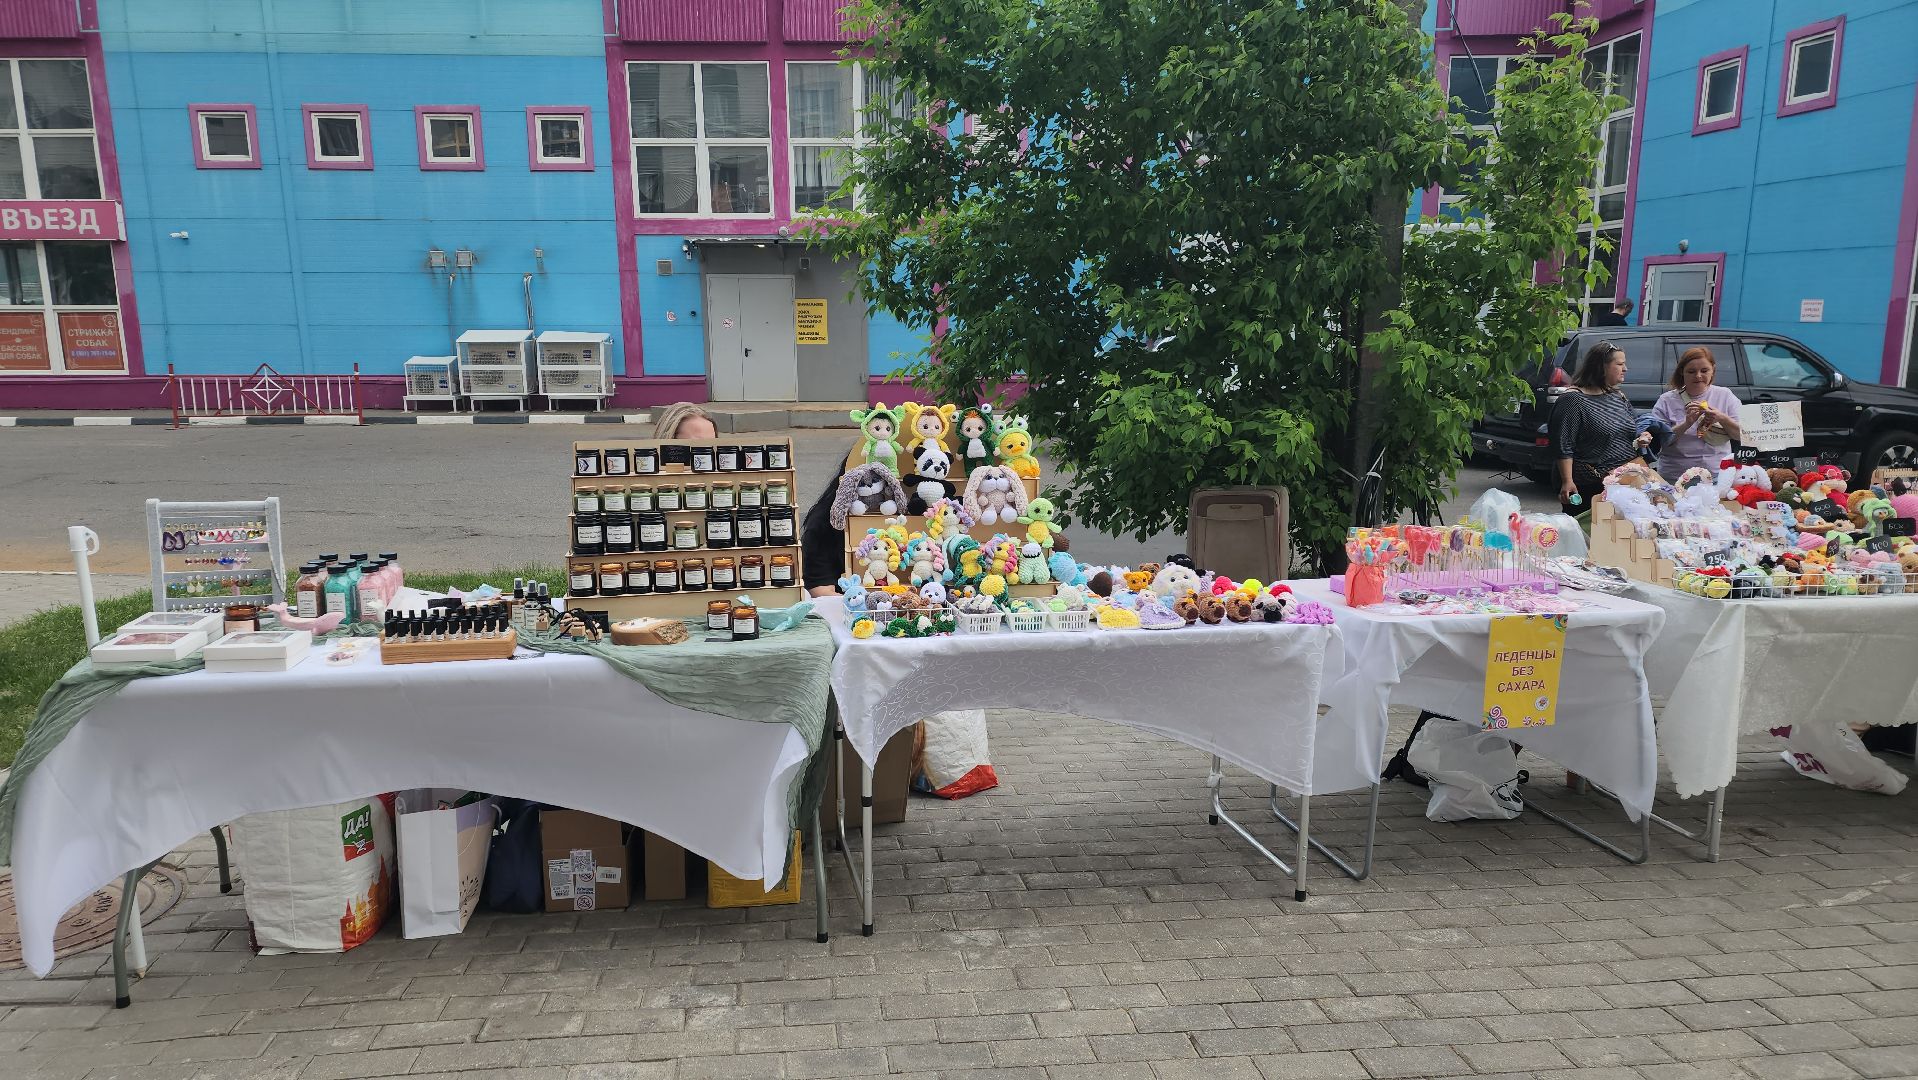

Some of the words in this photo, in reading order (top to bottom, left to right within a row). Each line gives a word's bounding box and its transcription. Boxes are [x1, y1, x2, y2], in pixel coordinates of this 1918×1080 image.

[2, 208, 100, 235] ВЪЕЗД
[68, 328, 114, 337] СТРИЖКА
[76, 339, 108, 347] СОБАК
[1771, 455, 1790, 463] 900
[1707, 553, 1726, 565] 250
[1494, 650, 1556, 663] ЛЕДЕНЦЫ
[1511, 666, 1535, 677] БЕЗ
[1497, 680, 1546, 693] САХАРА
[343, 811, 370, 840] ДА!
